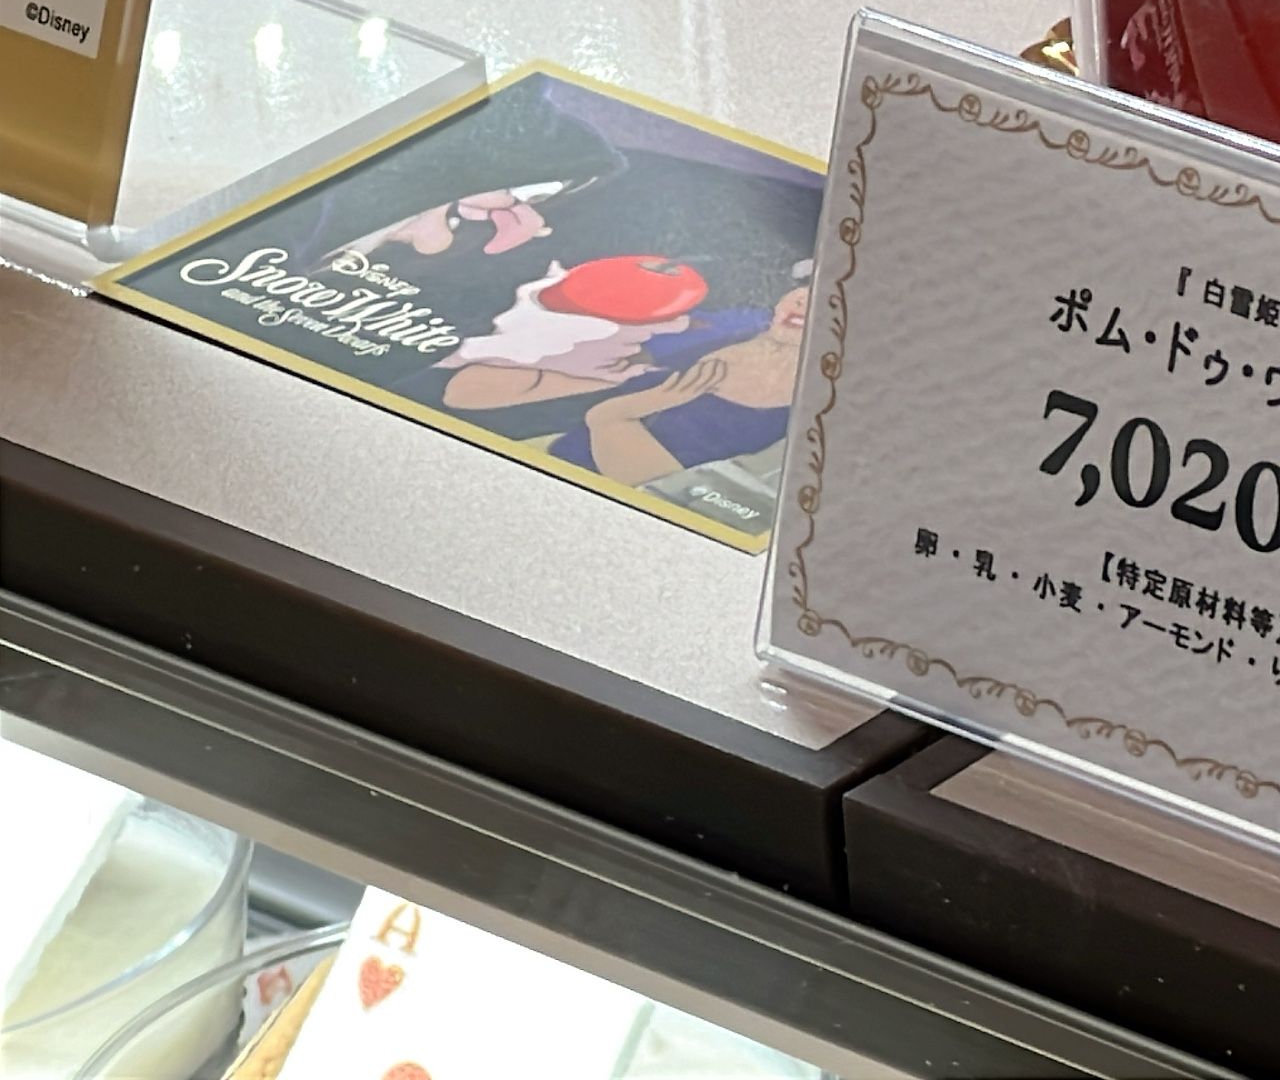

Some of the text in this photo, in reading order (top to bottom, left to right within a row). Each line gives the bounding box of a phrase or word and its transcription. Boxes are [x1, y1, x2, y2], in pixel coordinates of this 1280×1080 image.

[26, 2, 90, 44] ©Disney
[180, 247, 460, 353] Snow White
